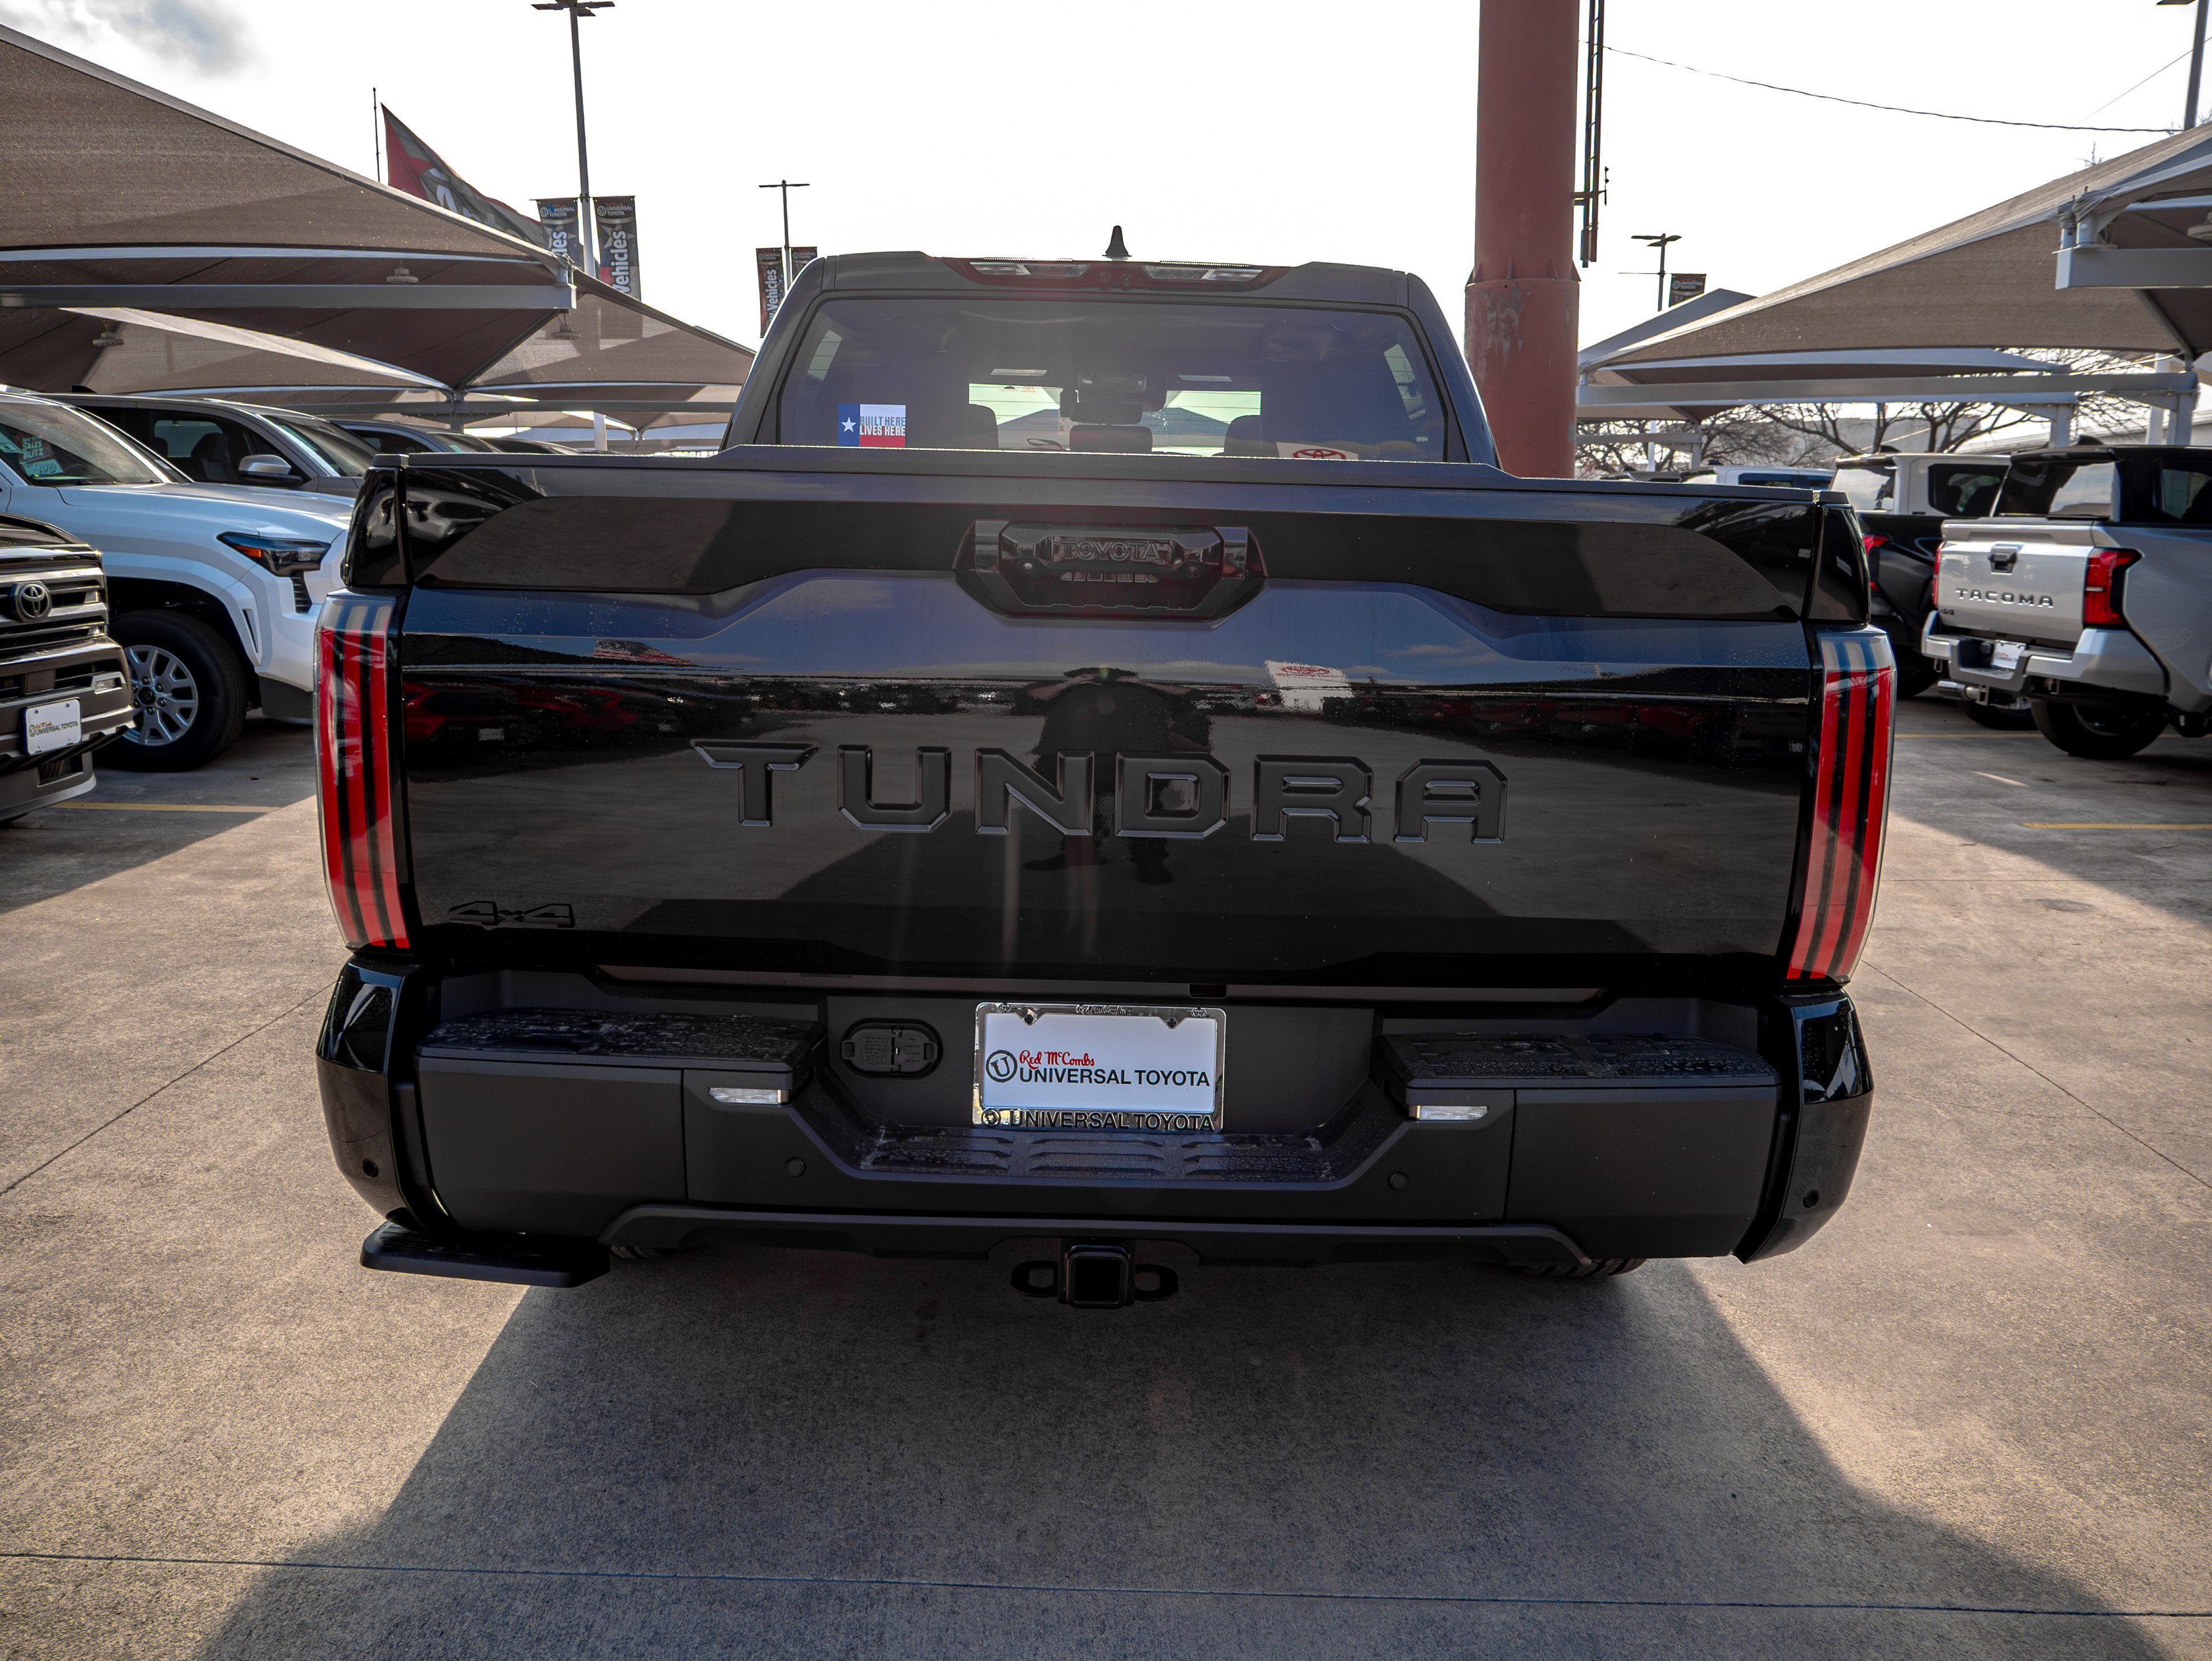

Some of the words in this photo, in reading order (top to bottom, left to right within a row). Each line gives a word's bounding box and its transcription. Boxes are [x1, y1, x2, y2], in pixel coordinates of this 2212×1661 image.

[609, 230, 631, 293] Vehicles
[765, 269, 778, 312] Vehicles
[860, 416, 883, 426] BUILT
[885, 417, 906, 426] HERE
[860, 425, 882, 436] LIVES
[884, 426, 906, 436] HERE
[22, 440, 42, 450] SALES
[24, 448, 44, 459] BLITZ
[1060, 539, 1161, 562] TOYOTA
[1956, 588, 2054, 608] TACOMA
[36, 725, 60, 736] UNIVERSAL
[61, 721, 78, 730] TOYOTA
[690, 739, 1508, 843] TUNDRA
[448, 901, 575, 928] 4x4
[1076, 1004, 1093, 1015] Red
[1019, 1050, 1042, 1070] Red
[1044, 1050, 1094, 1066] McCombs
[1020, 1067, 1131, 1085] UNIVERSAL
[1134, 1070, 1210, 1087] TOYOTA
[1009, 1109, 1130, 1129] UNIVERSAL
[1132, 1113, 1215, 1131] TOYOTA
